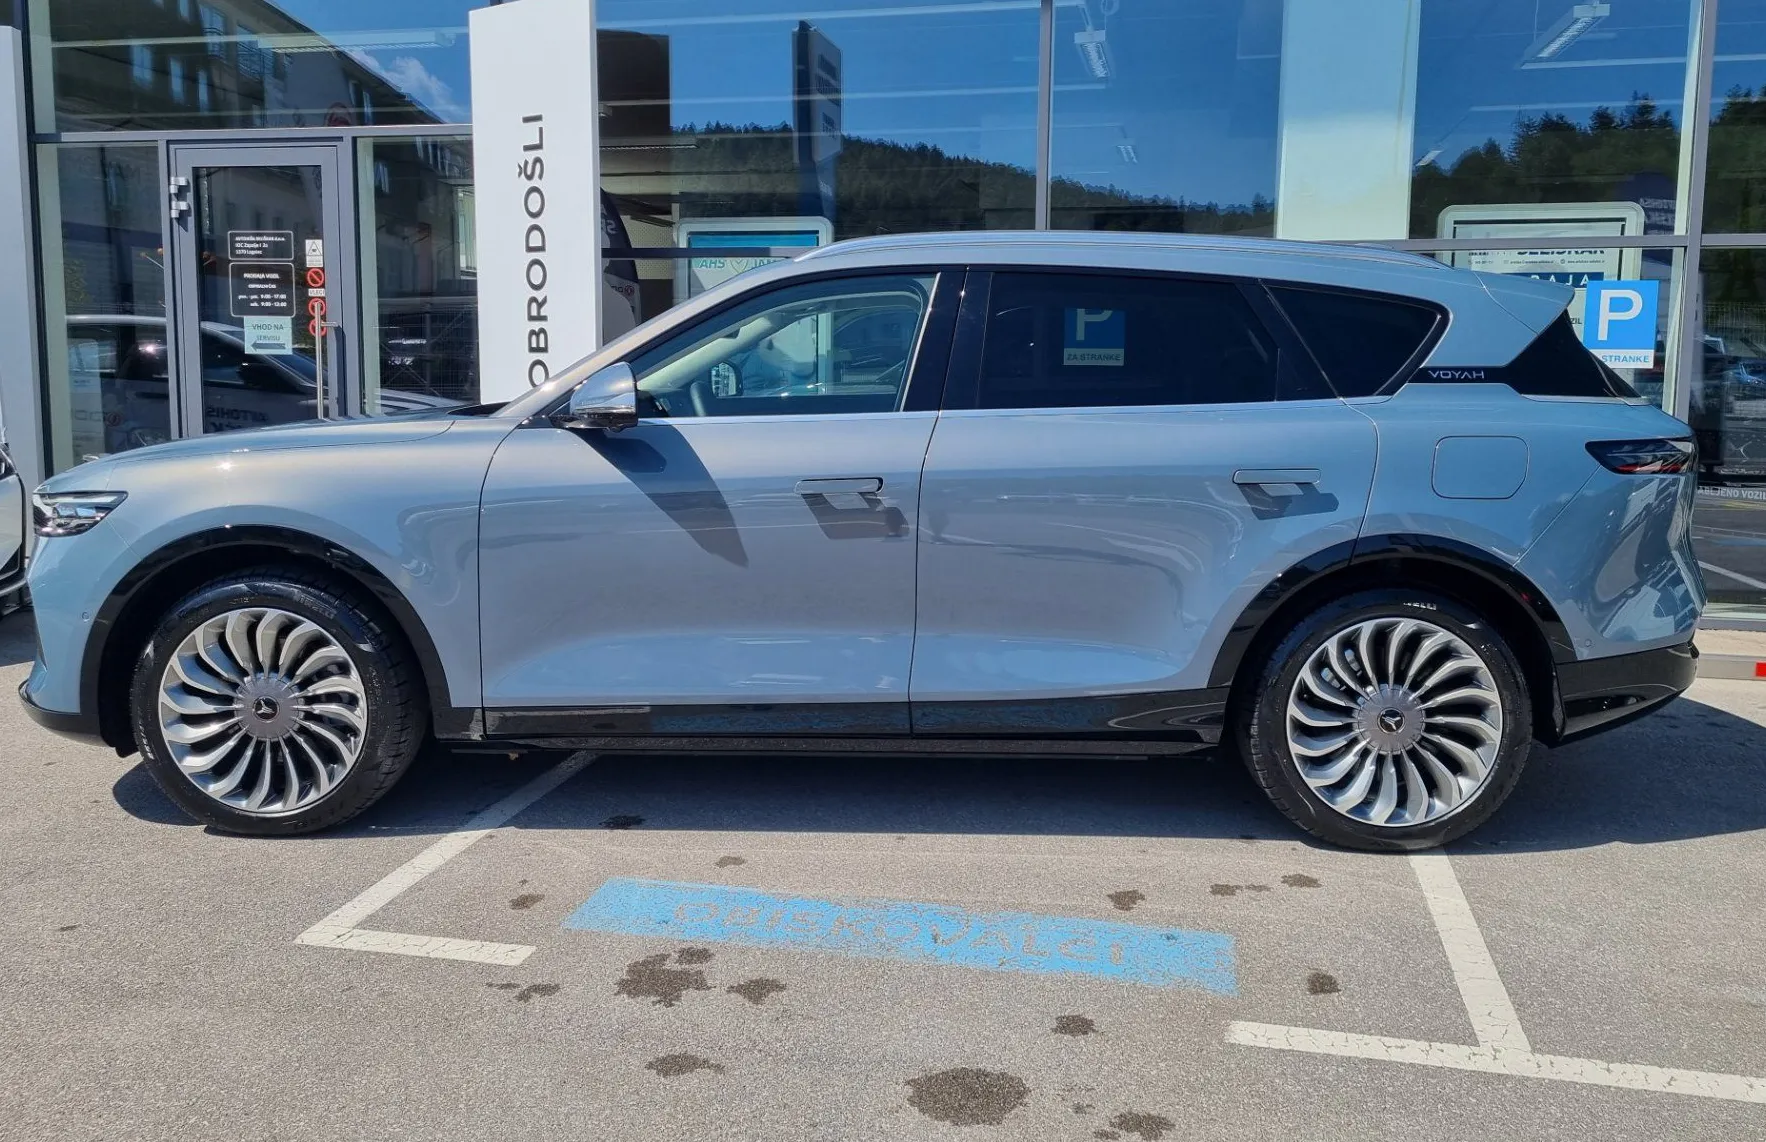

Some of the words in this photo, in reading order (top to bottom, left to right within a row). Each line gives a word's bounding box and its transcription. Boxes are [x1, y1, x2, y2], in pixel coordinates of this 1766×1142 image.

[1598, 290, 1643, 341] P
[252, 323, 272, 331] VHOD
[273, 323, 284, 331] NA
[1067, 353, 1078, 361] ZA
[1080, 353, 1122, 361] STRANKE
[1601, 354, 1650, 363] STRANKE
[1428, 370, 1485, 379] VOYAH
[674, 901, 1126, 966] OBISKOVALCI
